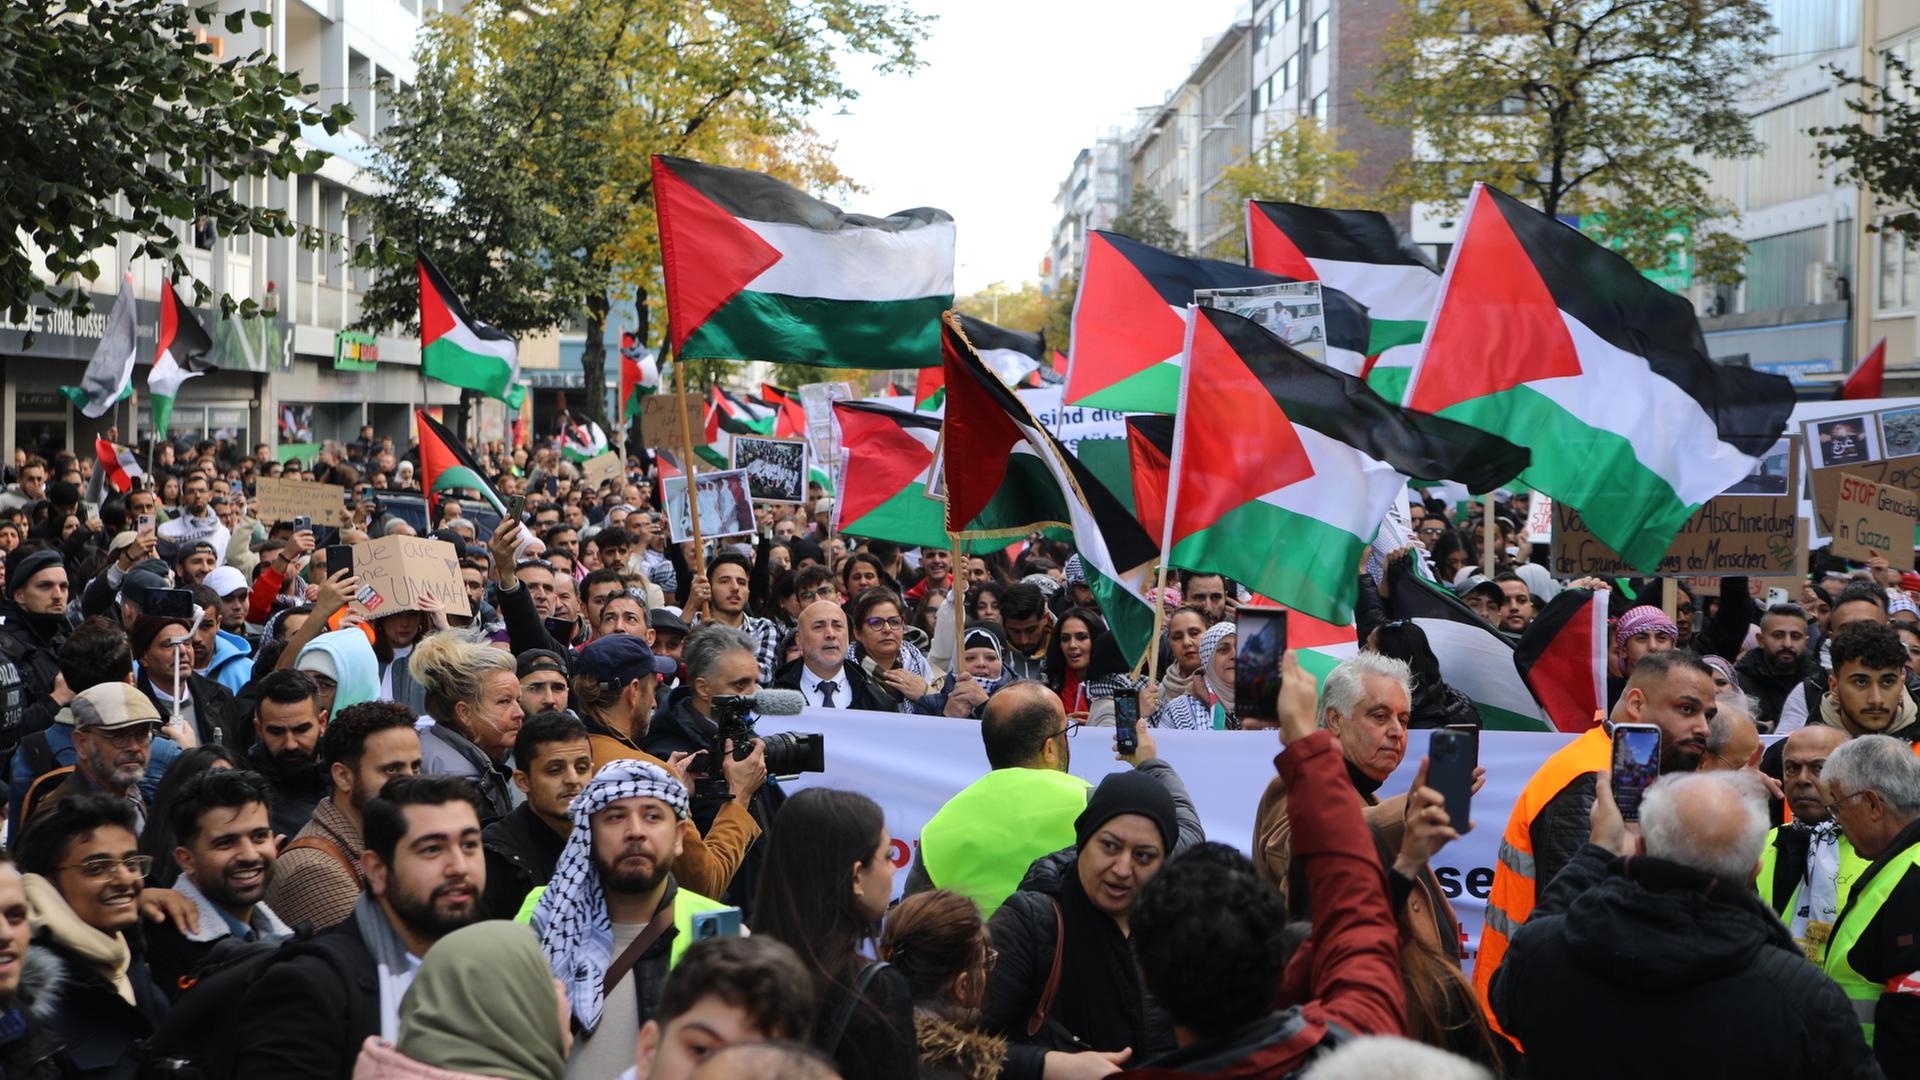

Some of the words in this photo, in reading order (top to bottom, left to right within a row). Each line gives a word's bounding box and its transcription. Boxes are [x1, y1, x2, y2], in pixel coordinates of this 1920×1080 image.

[47, 308, 75, 334] STORE
[1039, 408, 1083, 426] sind
[1092, 407, 1124, 422] die
[1841, 478, 1876, 507] STOP
[1696, 498, 1795, 538] Abschneidung
[1840, 520, 1849, 539] in
[1856, 517, 1890, 550] Gaza
[404, 541, 438, 559] are
[1555, 544, 1577, 573] der
[1688, 549, 1702, 568] der
[1703, 538, 1767, 570] Menschen
[391, 575, 466, 608] UMMAH
